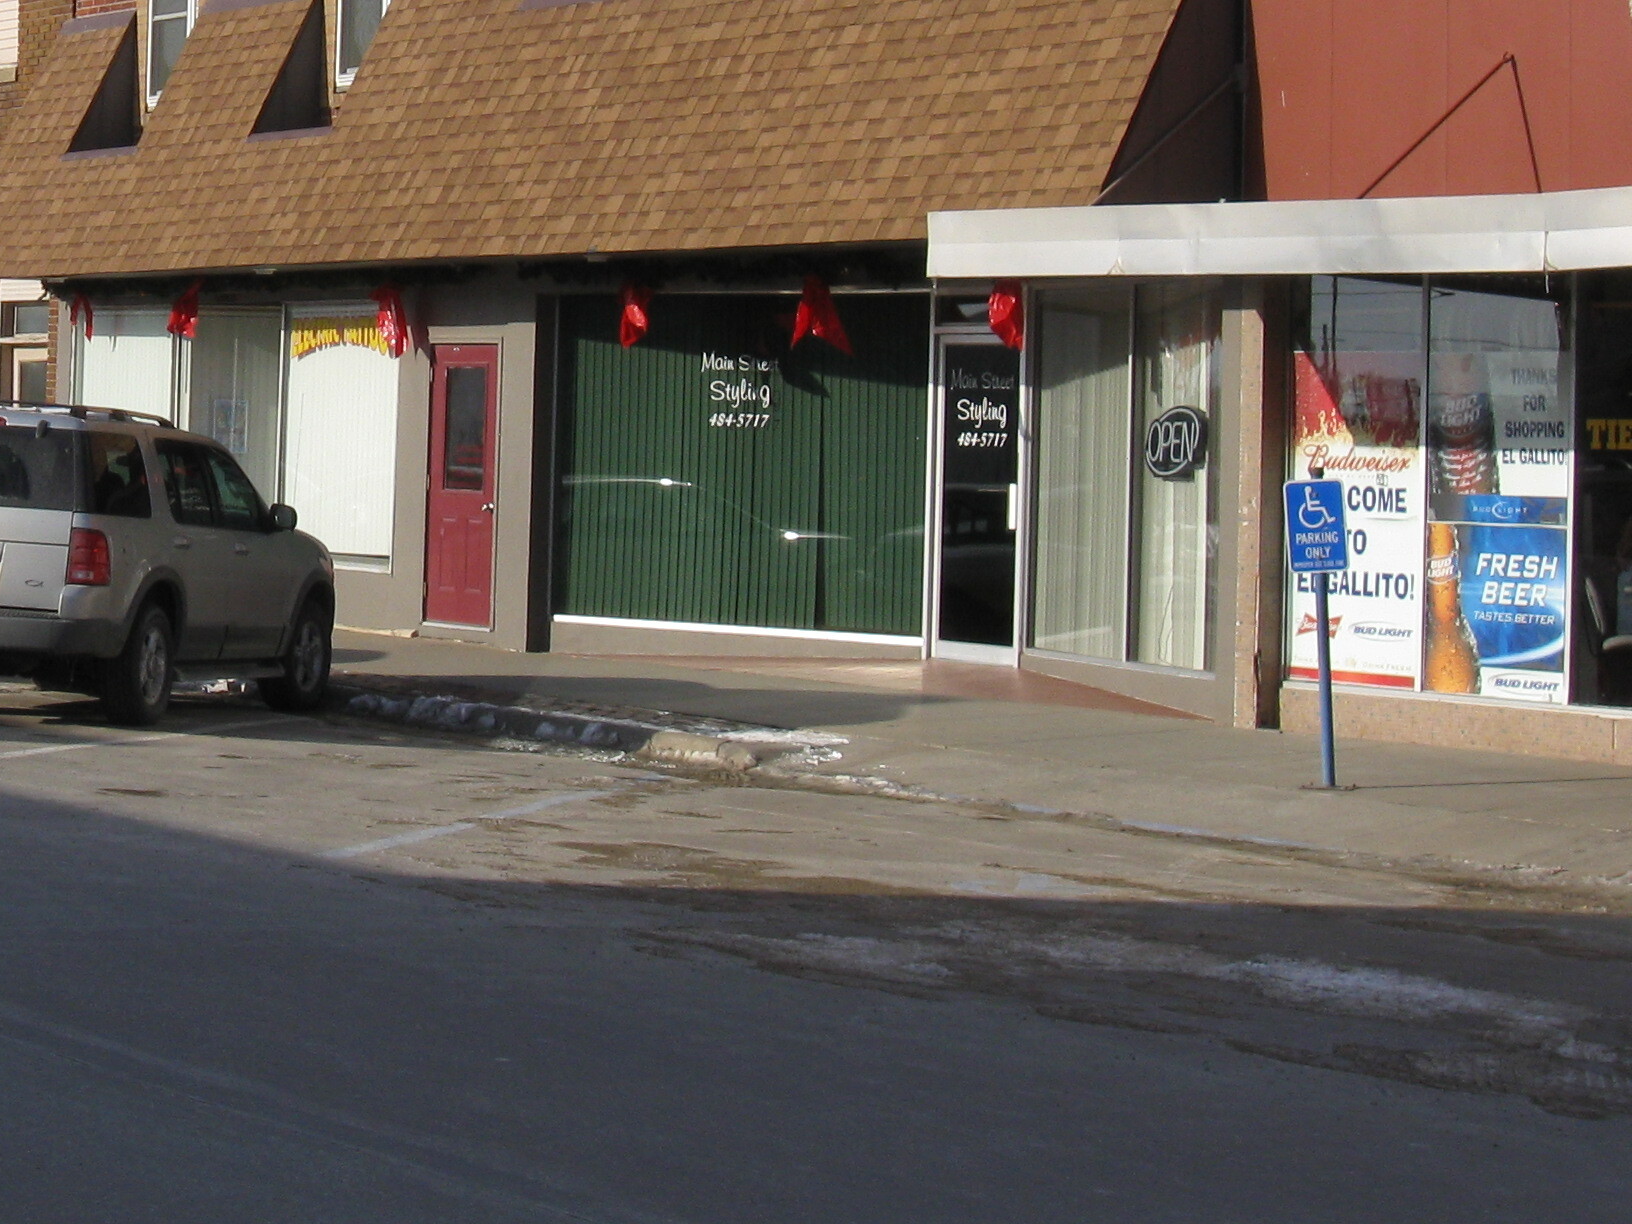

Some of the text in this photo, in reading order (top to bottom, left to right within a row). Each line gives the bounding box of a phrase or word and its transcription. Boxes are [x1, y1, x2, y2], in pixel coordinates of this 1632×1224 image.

[701, 350, 779, 373] Main Sreet
[950, 368, 1015, 390] Main Street
[1511, 367, 1559, 385] THANKS
[1523, 395, 1546, 412] FOR
[709, 413, 770, 428] 484-5717
[957, 396, 1007, 429] Styling
[1505, 421, 1565, 438] SHOPPING
[957, 431, 1008, 448] 484-5717
[1148, 421, 1195, 463] OPEN
[1304, 444, 1412, 472] Budweiser
[1502, 447, 1516, 464] EL
[1347, 485, 1407, 513] COME
[1295, 531, 1339, 545] PARKING
[1346, 528, 1367, 555] O
[1305, 546, 1332, 559] ONLY
[1475, 552, 1558, 579] FRESH
[1481, 581, 1547, 607] BEER
[1474, 610, 1555, 625] TASTES BETTER
[1353, 625, 1377, 635] BUD
[1378, 626, 1413, 638] LIGHT
[1494, 679, 1560, 691] BUD LIGHT
